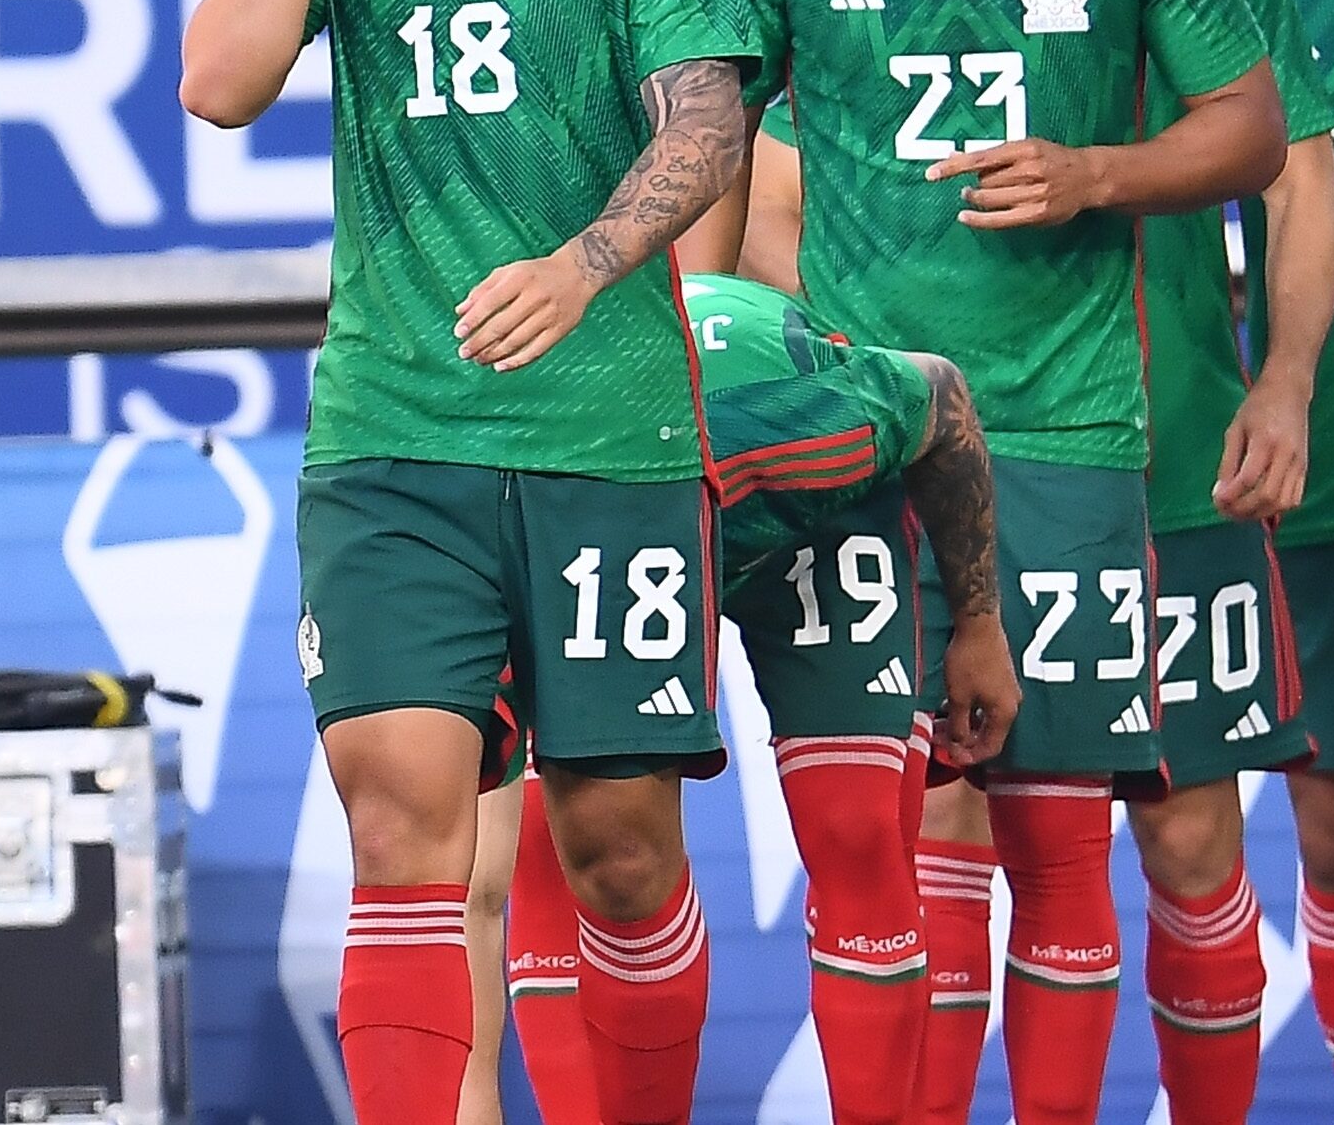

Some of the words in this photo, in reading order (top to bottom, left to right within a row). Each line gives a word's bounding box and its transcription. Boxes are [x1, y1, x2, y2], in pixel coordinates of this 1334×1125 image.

[398, 1, 519, 118] 18
[889, 51, 1028, 161] 23
[563, 546, 687, 660] 18
[784, 536, 899, 646] 19
[1020, 568, 1145, 682] 23
[1156, 581, 1260, 703] 20
